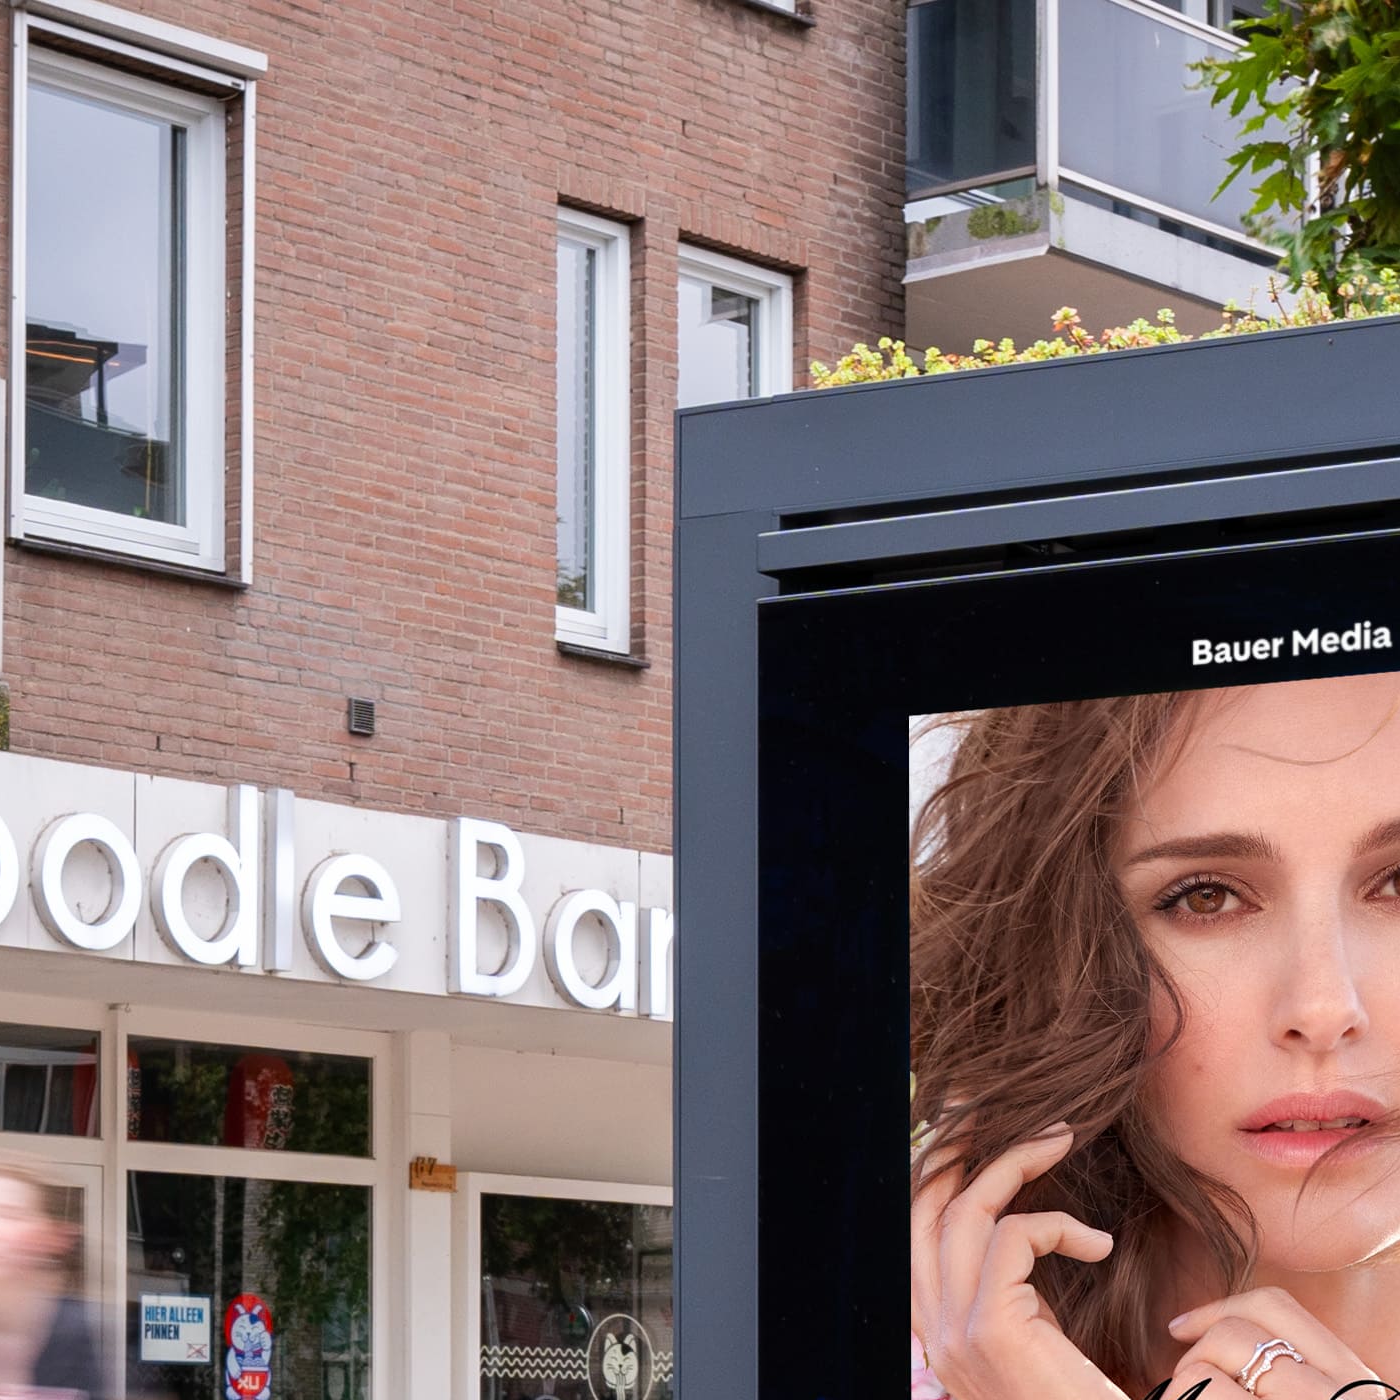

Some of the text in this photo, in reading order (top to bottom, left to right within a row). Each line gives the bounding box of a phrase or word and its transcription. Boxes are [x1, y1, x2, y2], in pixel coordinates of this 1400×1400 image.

[1192, 620, 1393, 666] Bauer Media
[144, 1305, 204, 1324] HIER ALLEEN
[144, 1323, 181, 1340] PINNEN
